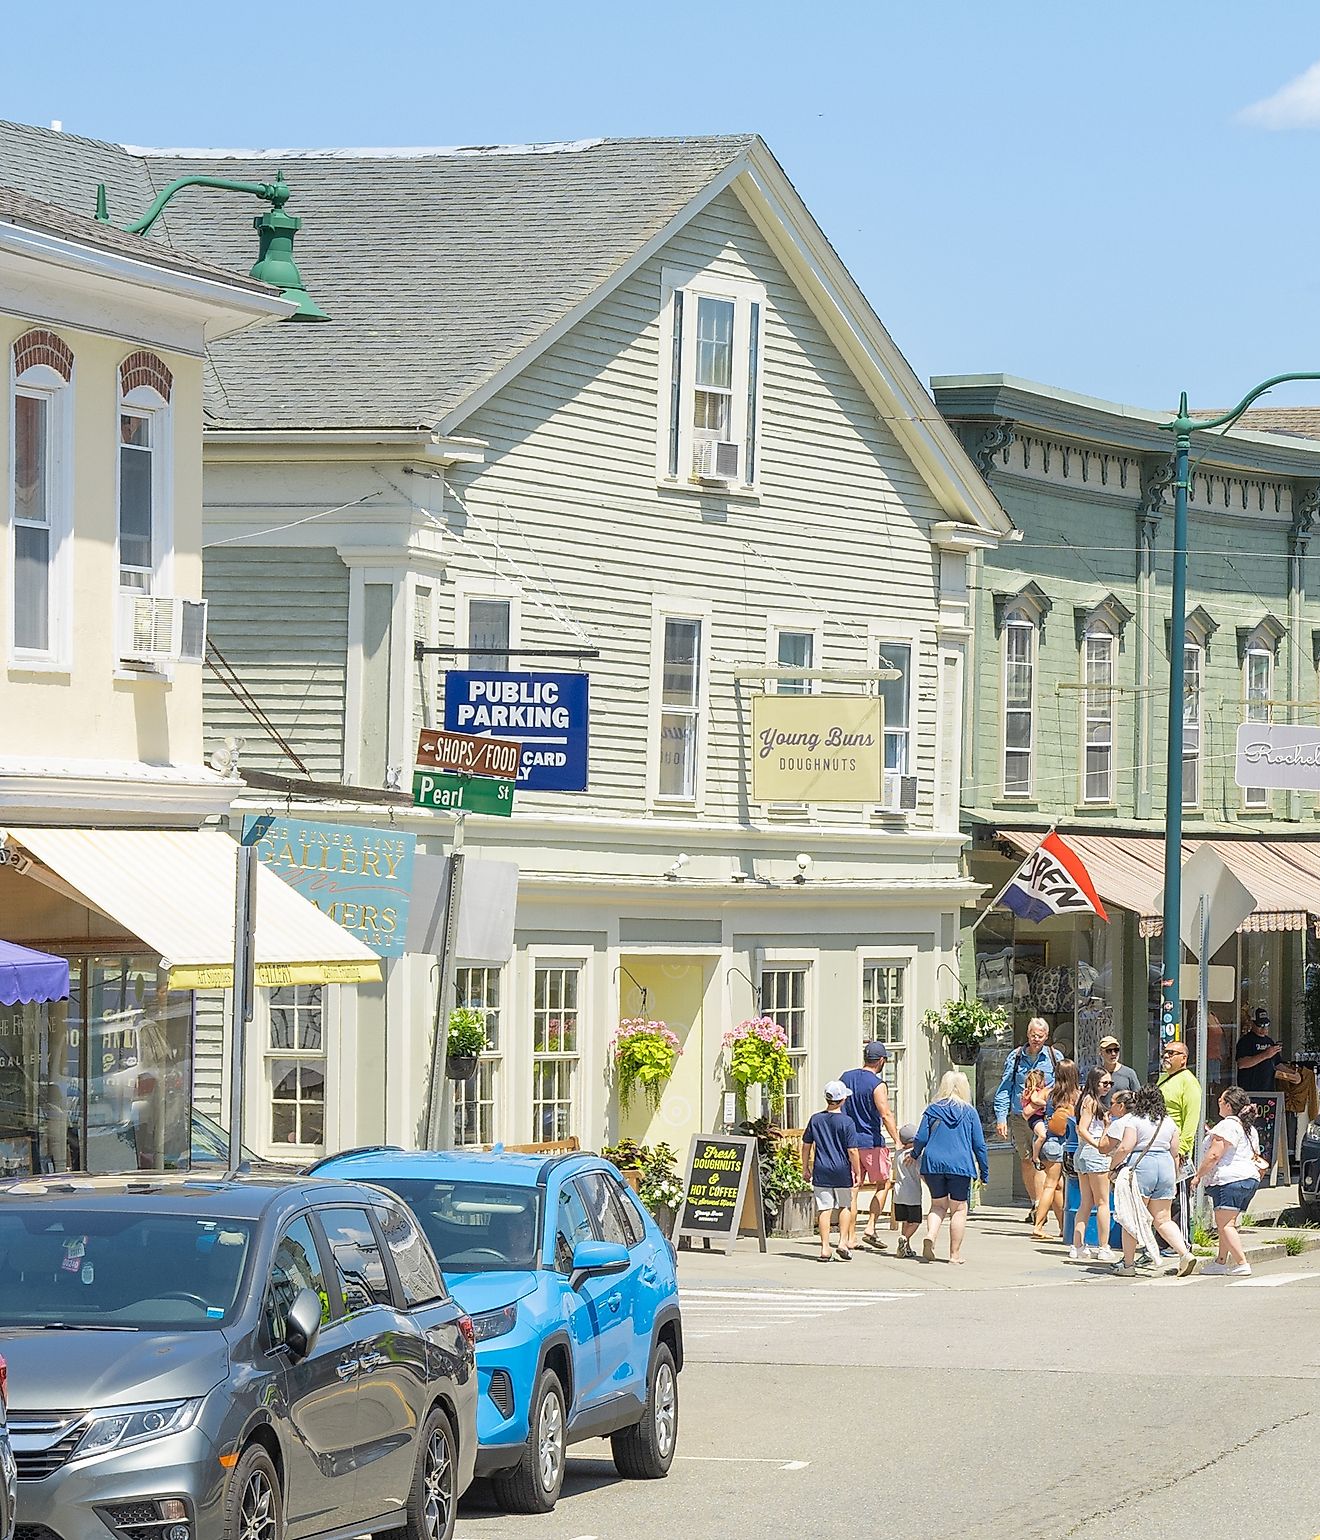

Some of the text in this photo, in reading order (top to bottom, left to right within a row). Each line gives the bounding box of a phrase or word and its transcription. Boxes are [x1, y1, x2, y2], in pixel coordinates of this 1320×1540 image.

[468, 680, 559, 704] PUBLIC
[457, 704, 570, 729] PARKING
[435, 736, 517, 772] SHOPS/FOOD
[759, 726, 875, 759] Young Buns
[522, 751, 567, 766] CARD
[779, 757, 857, 771] DOUGHNUTS
[419, 776, 509, 807] Pearl St
[255, 824, 405, 853] THE FINER LINE
[253, 838, 405, 880] GALLERY
[1016, 852, 1089, 908] OPEN
[310, 899, 397, 933] MERS
[362, 934, 392, 947] ART
[694, 1158, 741, 1171] DOUGHNUTS
[703, 1146, 737, 1160] Fresh
[708, 1172, 720, 1185] &
[690, 1184, 738, 1198] HOT COFFEE
